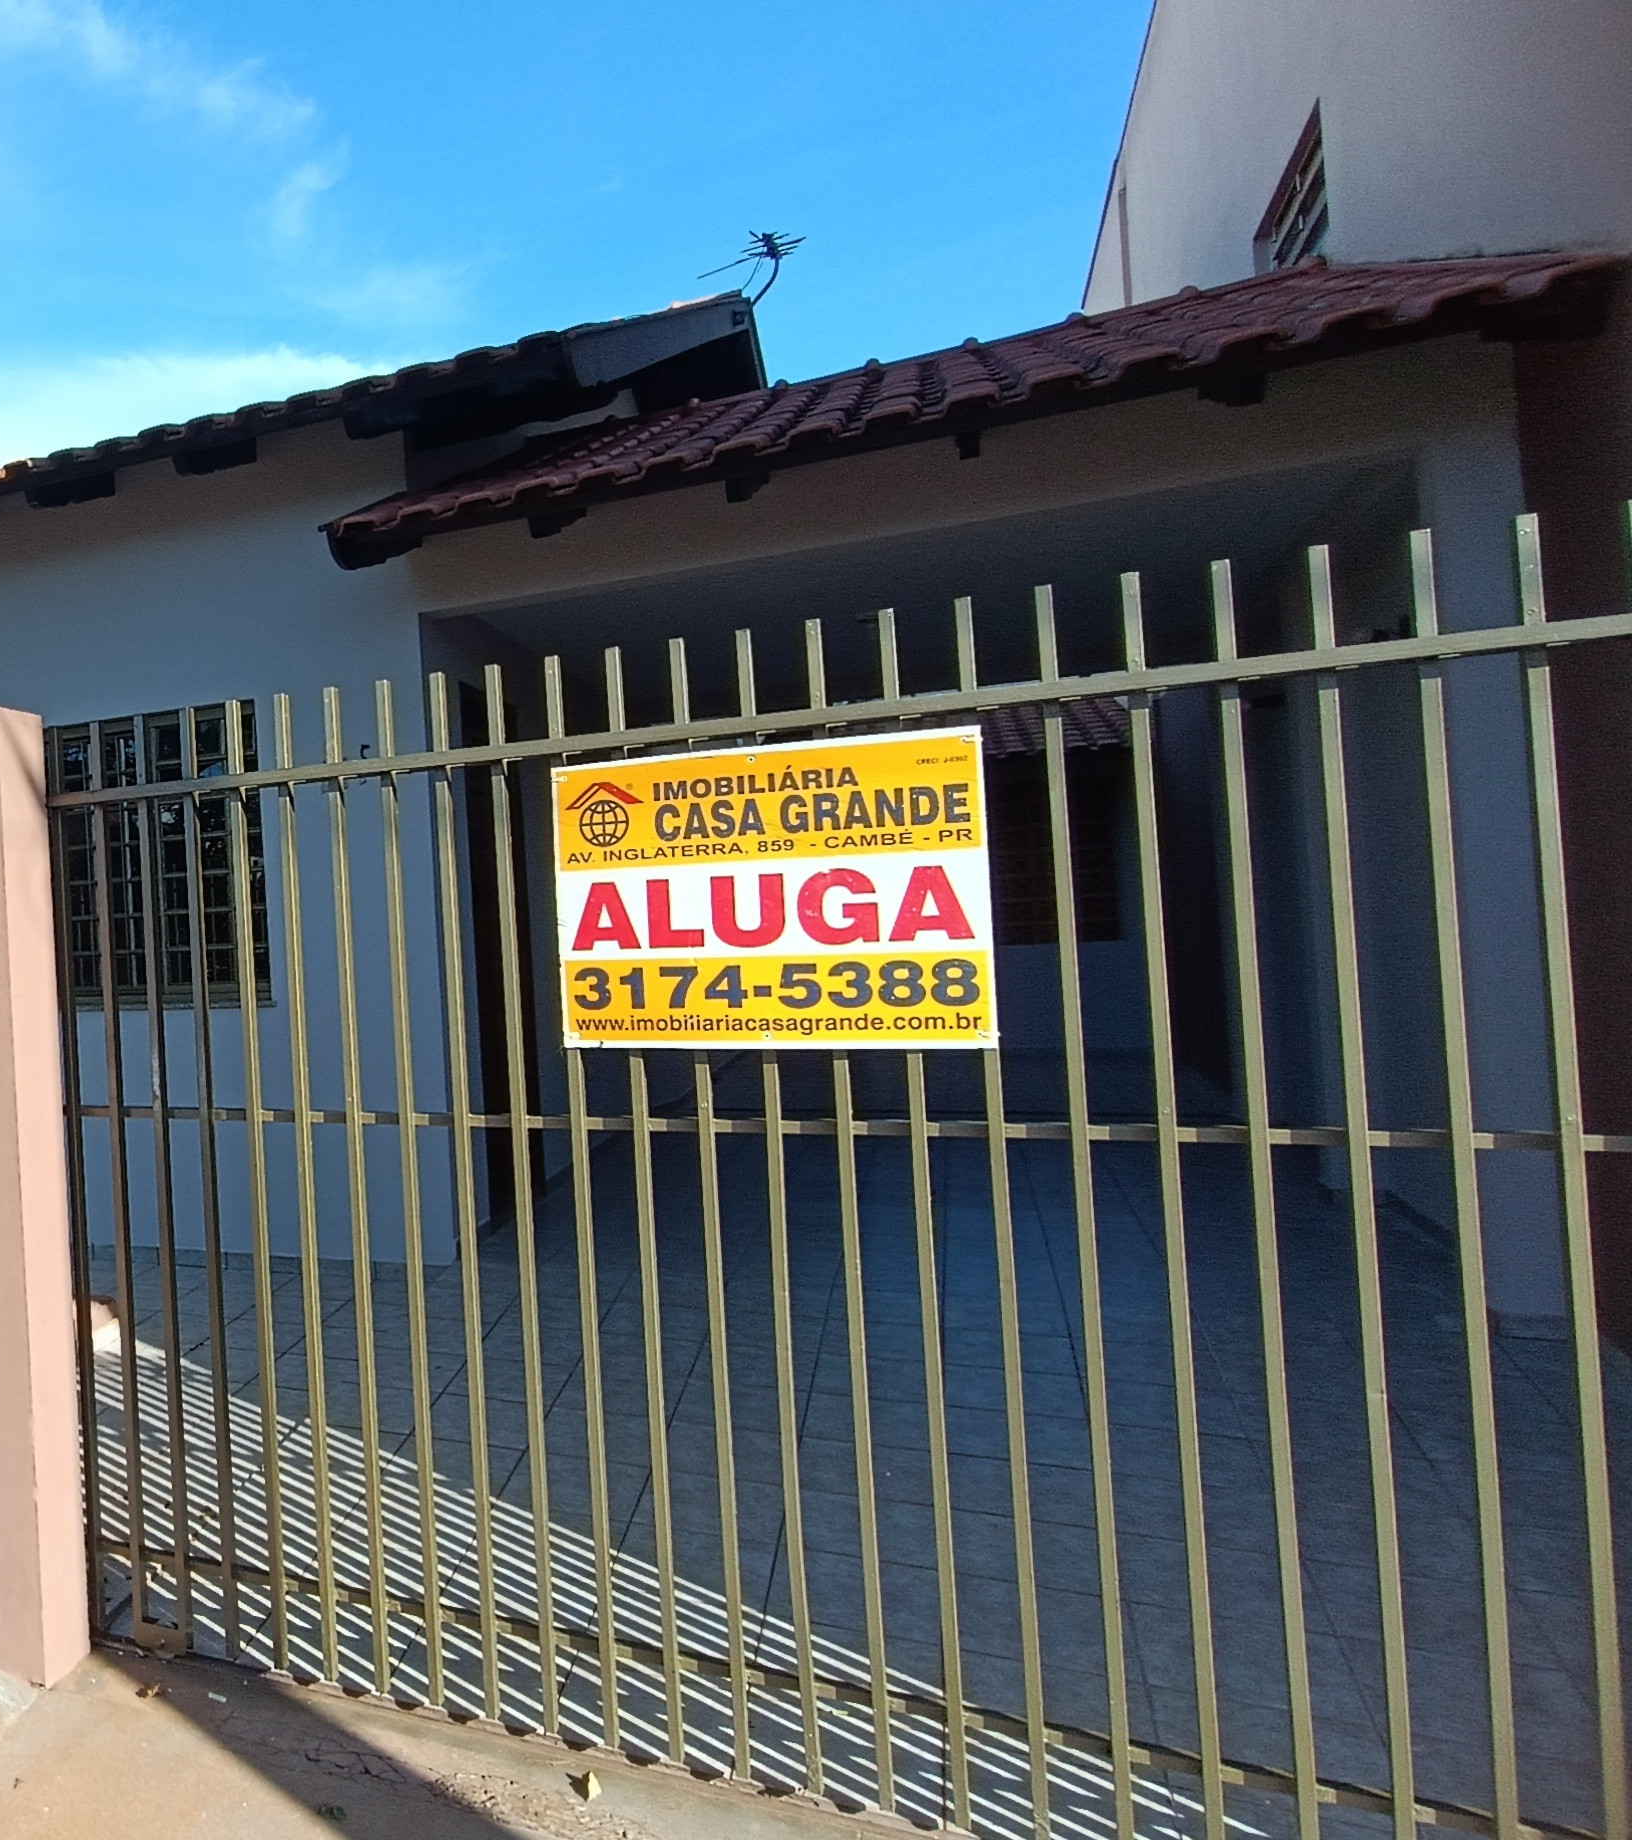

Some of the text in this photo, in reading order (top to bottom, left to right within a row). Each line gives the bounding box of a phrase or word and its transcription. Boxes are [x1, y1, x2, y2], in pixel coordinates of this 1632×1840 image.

[652, 765, 859, 802] IMOBILIÁRIA
[654, 783, 971, 842] CASA GRANDE
[567, 852, 596, 864] AV.
[603, 843, 750, 862] INGLATERRA,
[757, 838, 795, 853] 859
[824, 829, 914, 849] CAMBÉ
[938, 828, 973, 842] PR
[571, 866, 976, 951] ALUGA
[573, 958, 981, 1011] 3174-5388
[575, 1012, 983, 1036] www.imobiliariacasagrande.com.br
